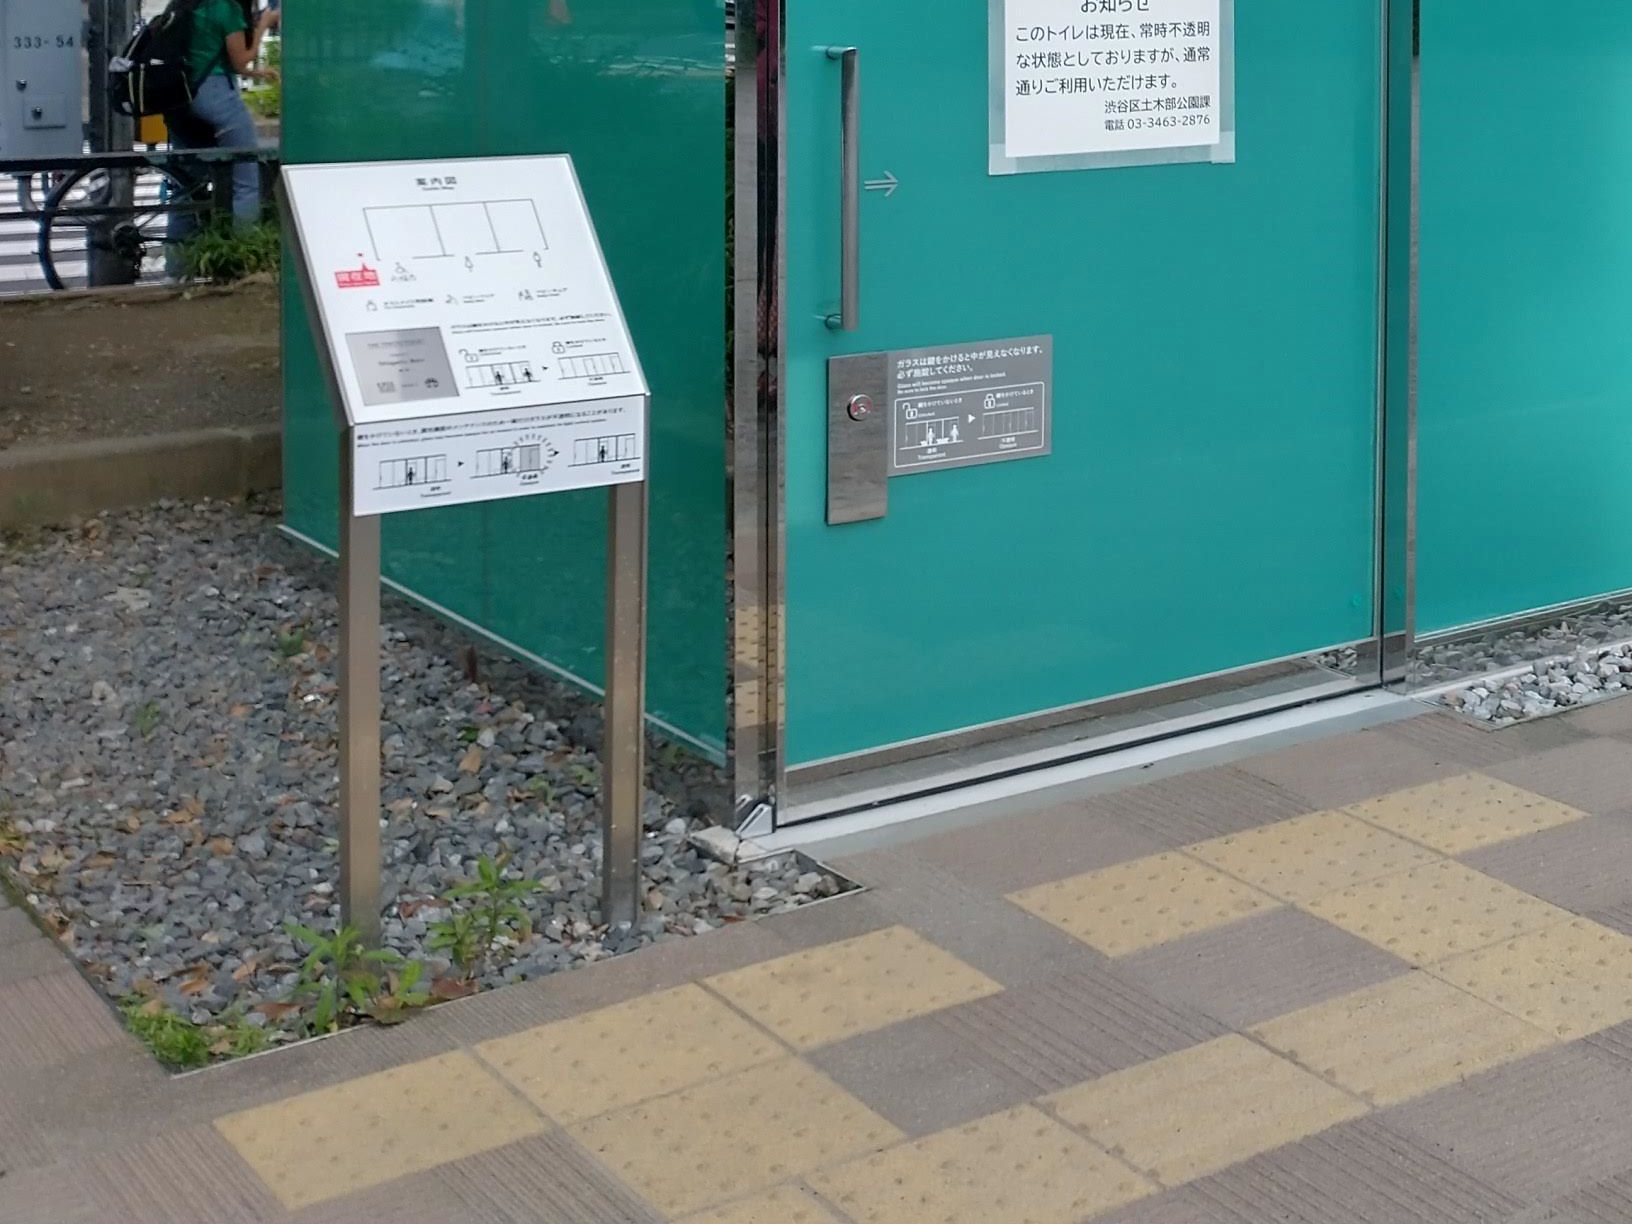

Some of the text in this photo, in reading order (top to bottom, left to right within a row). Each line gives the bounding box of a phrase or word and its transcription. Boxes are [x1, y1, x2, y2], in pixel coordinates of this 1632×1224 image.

[1015, 21, 1211, 42] このトイレは現在、常時不透明
[1015, 46, 1211, 69] な状態としておりますが、通常
[1015, 73, 1177, 96] 通りご利用いただけます。
[1104, 95, 1211, 115] 渋谷区土木部公園課
[1104, 114, 1211, 131] 電話 03-3463-2876
